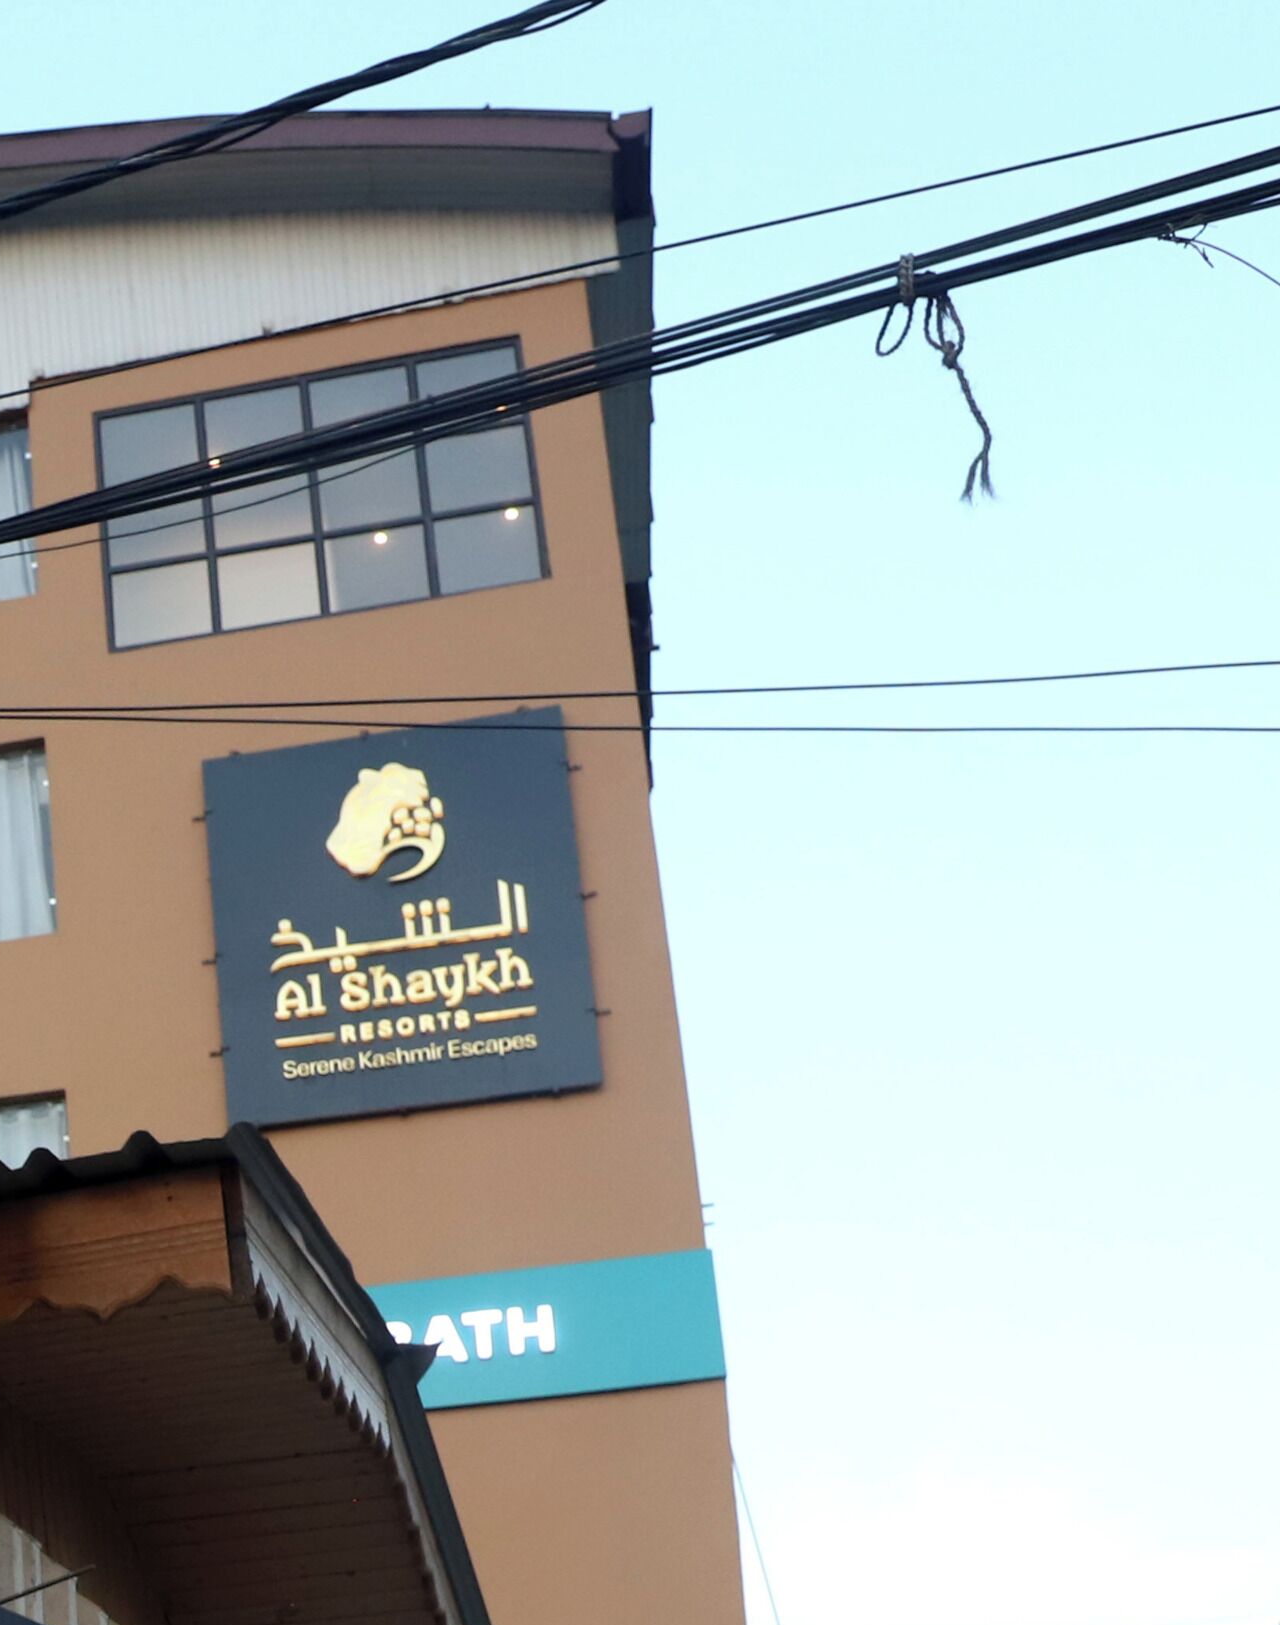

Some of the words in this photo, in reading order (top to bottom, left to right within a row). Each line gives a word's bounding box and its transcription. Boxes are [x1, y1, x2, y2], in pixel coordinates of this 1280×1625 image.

[274, 973, 327, 1021] Al
[340, 948, 534, 1010] Shaykh
[340, 1010, 471, 1044] RESORTS
[282, 1053, 356, 1081] Serene
[359, 1043, 444, 1071] Kashmir
[448, 1032, 538, 1058] Escapes
